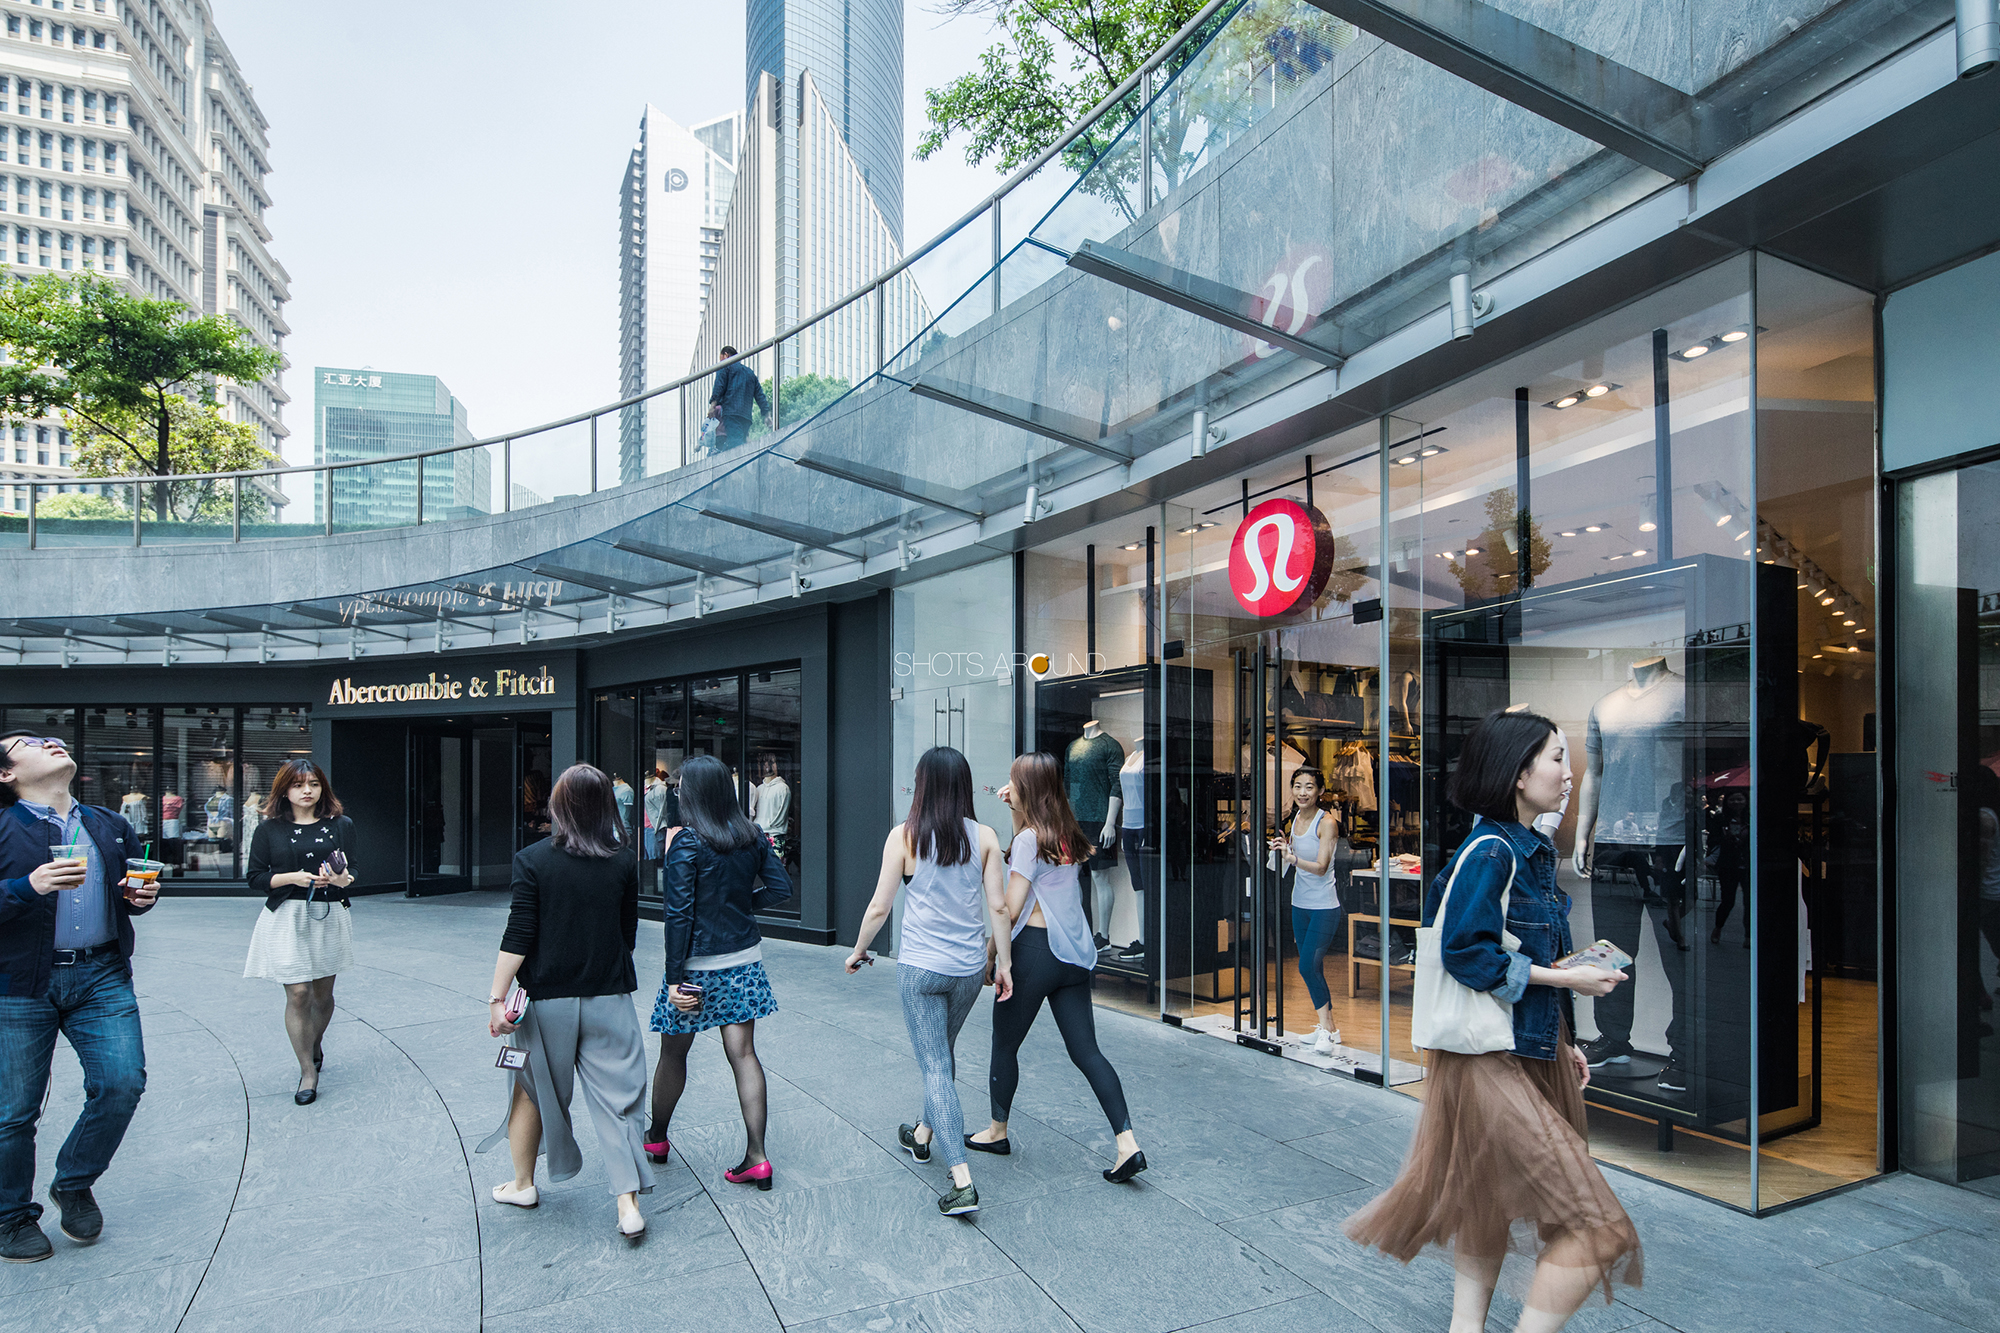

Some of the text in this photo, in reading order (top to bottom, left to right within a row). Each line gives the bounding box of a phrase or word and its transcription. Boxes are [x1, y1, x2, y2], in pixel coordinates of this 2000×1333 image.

[323, 372, 383, 389] 汇亚大厦
[327, 665, 556, 705] Abercrombie & Fitch
